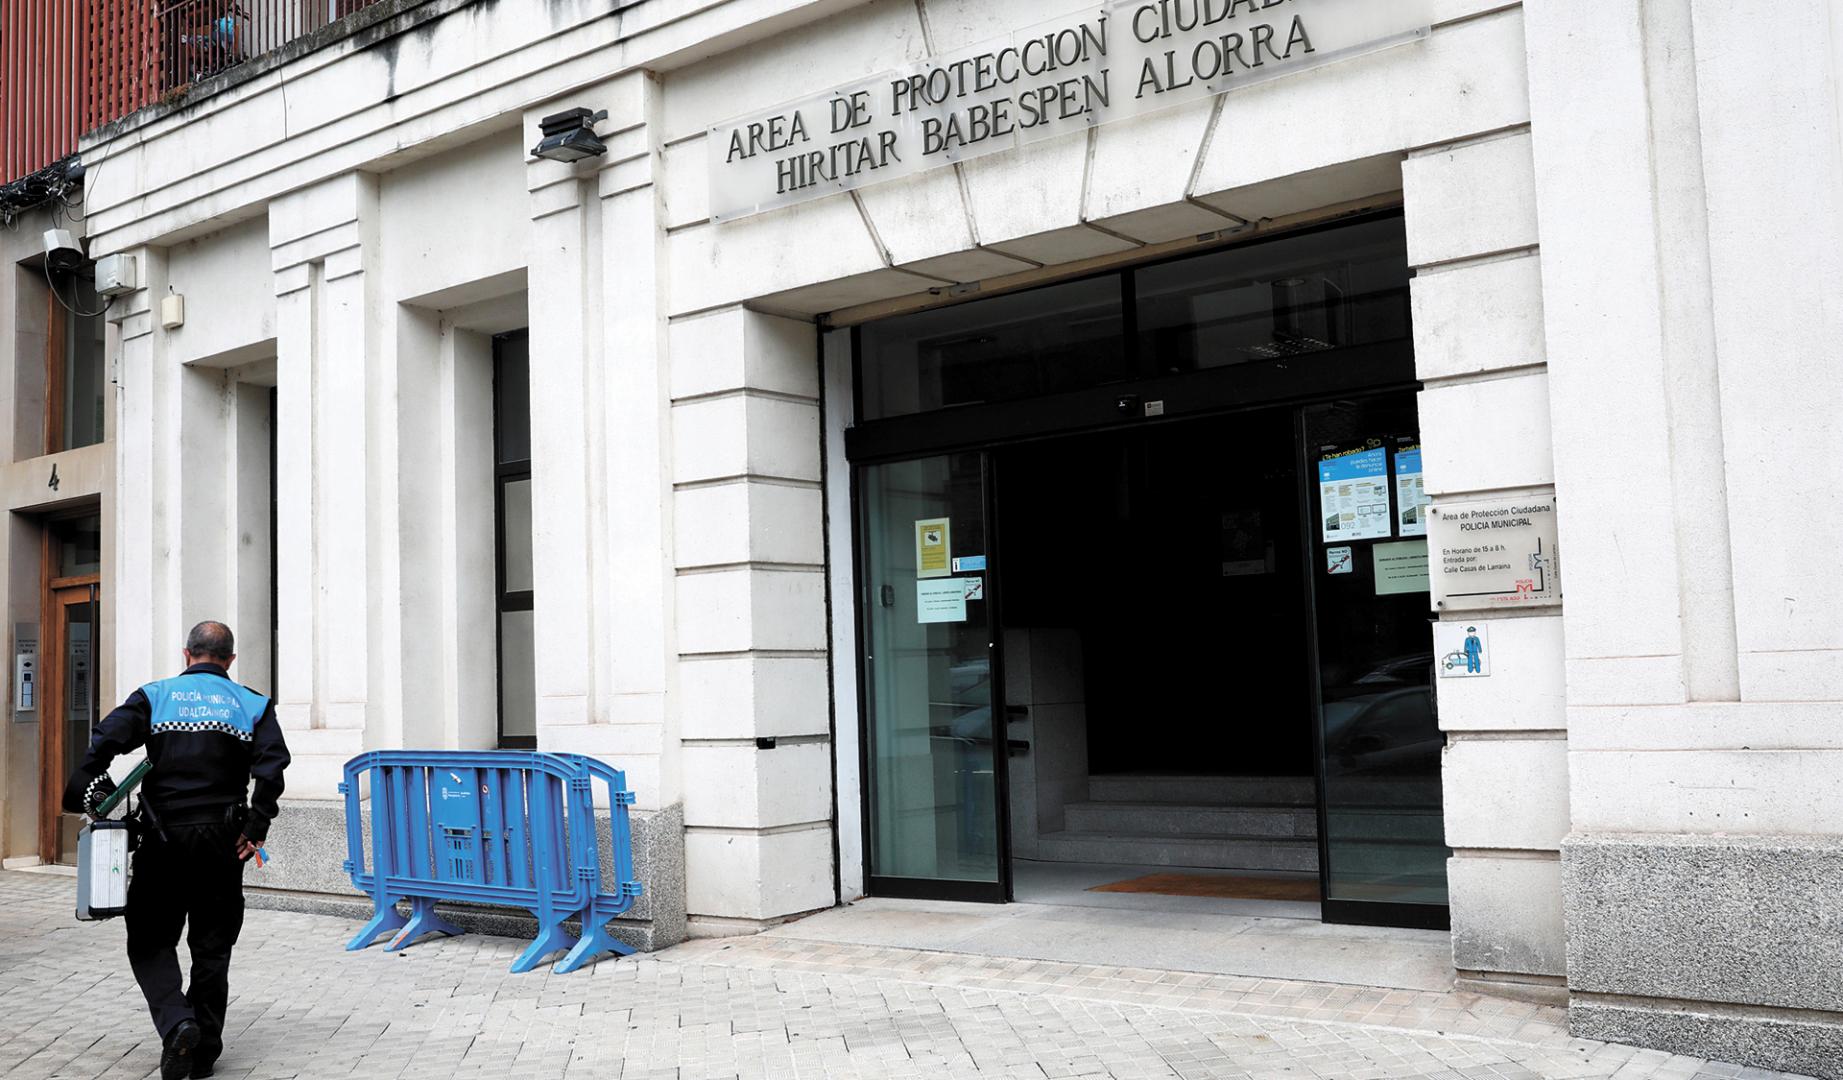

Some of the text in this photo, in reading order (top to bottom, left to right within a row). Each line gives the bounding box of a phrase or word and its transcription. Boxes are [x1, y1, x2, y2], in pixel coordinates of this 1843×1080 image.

[726, 110, 810, 163] AREA
[829, 90, 872, 134] DE
[891, 17, 1107, 117] PROTECCION
[776, 14, 1315, 194] HIRITAR BABESPEN ALORRA
[48, 463, 60, 491] 4
[1460, 512, 1469, 520] de
[1511, 505, 1551, 515] Ciudadana
[1491, 518, 1532, 529] MUNICIPAL
[1443, 555, 1465, 564] Entrada
[1444, 566, 1458, 574] Calle
[1460, 565, 1477, 573] Casas
